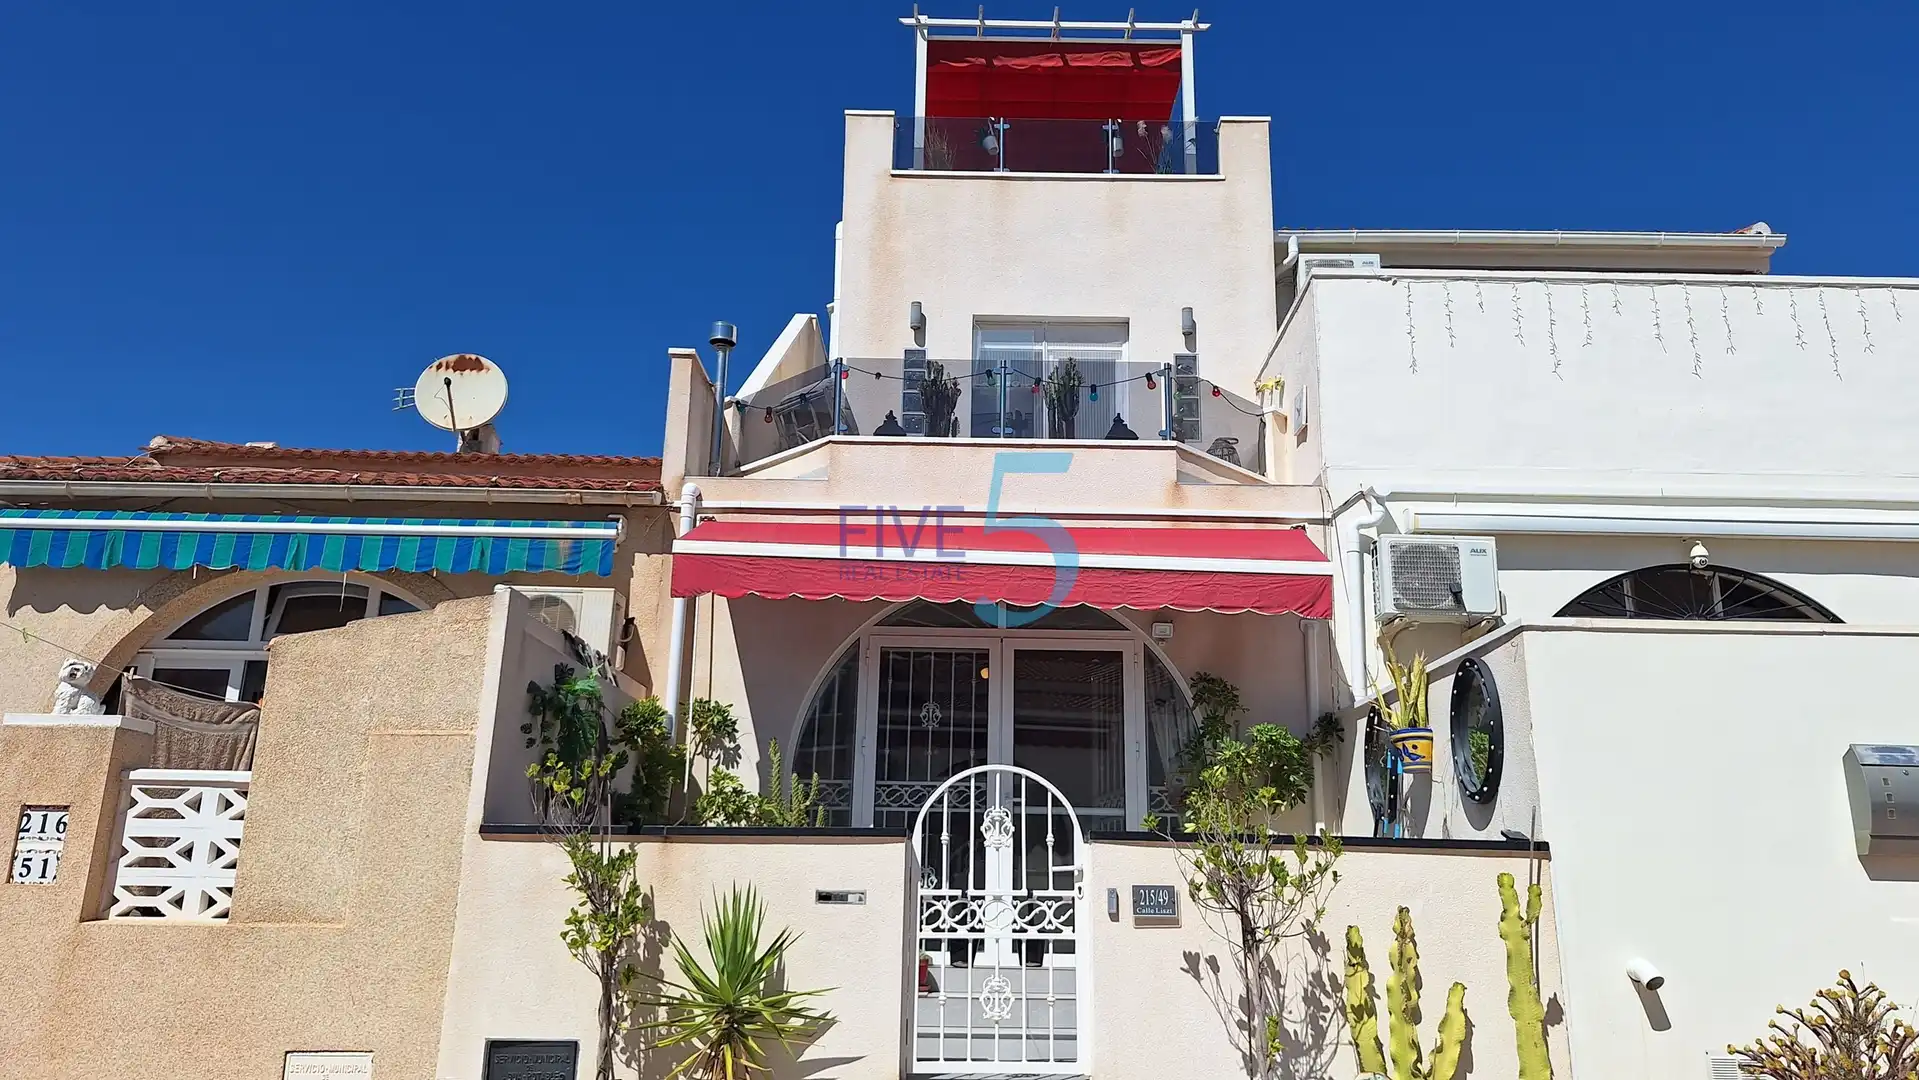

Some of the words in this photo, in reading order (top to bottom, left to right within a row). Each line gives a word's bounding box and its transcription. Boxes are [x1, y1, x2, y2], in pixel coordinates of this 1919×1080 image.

[19, 812, 69, 834] 216
[18, 857, 49, 879] 51
[1139, 889, 1169, 906] 215/49
